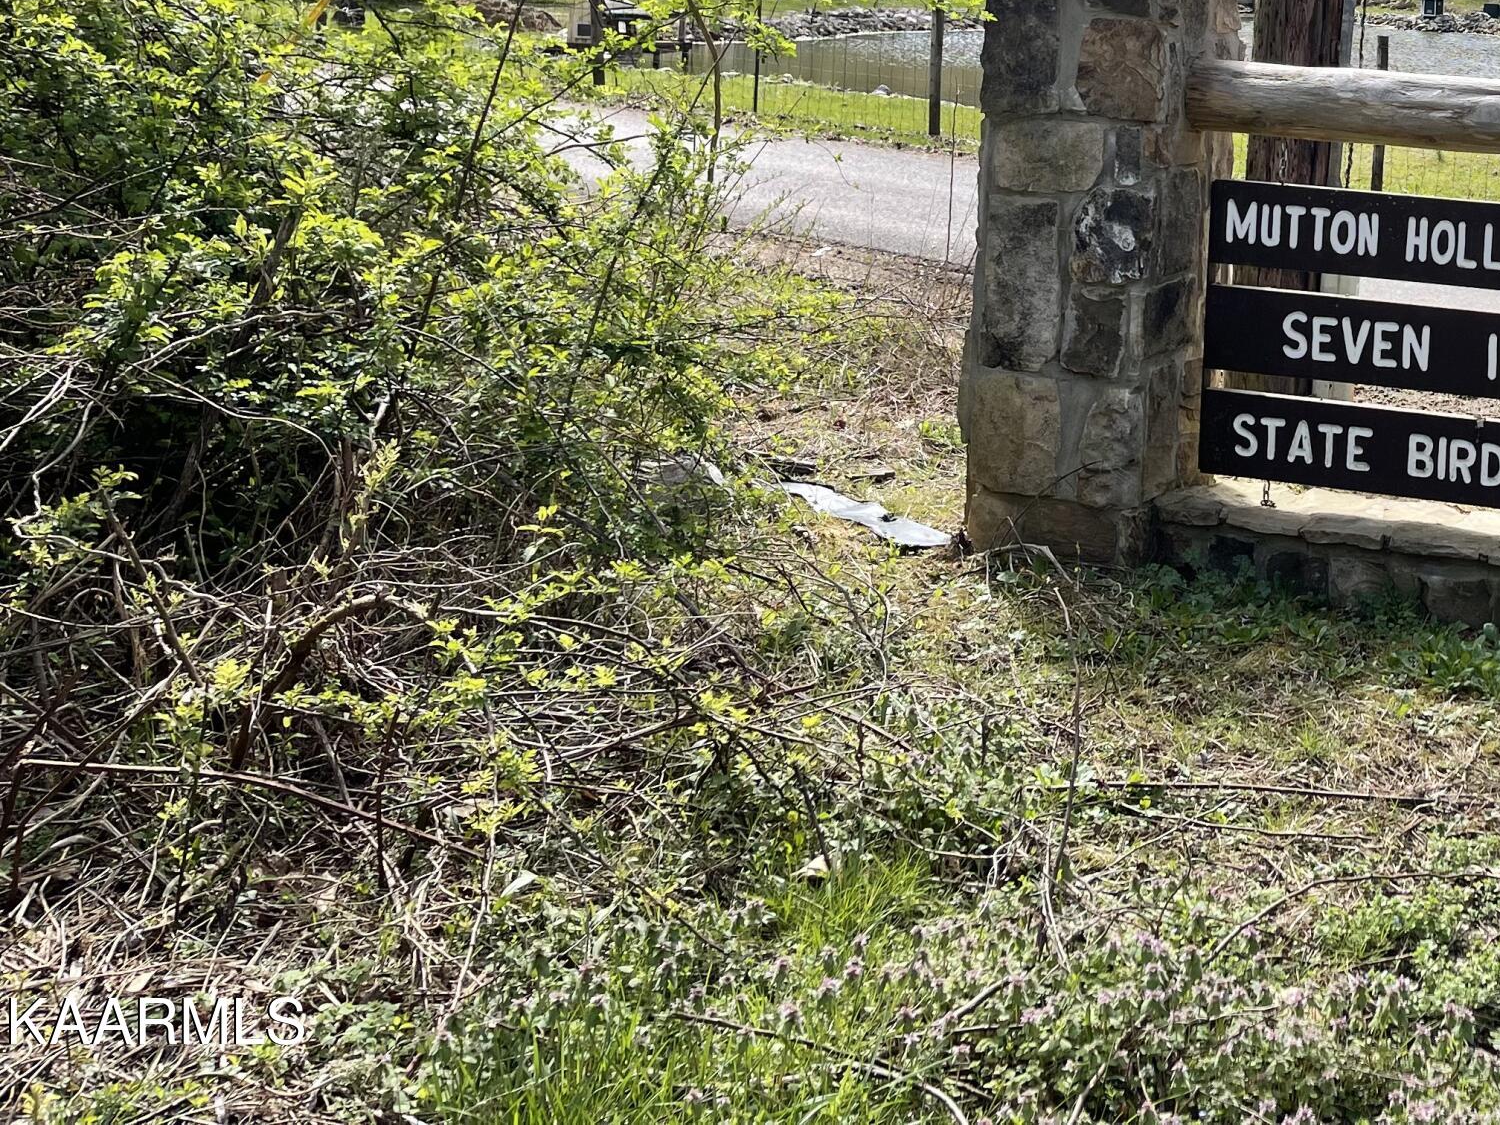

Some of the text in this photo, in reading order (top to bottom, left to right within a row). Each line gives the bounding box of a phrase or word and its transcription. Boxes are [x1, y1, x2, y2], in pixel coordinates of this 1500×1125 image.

[1224, 199, 1380, 258] MUTTON
[1281, 311, 1432, 373] SEVEN
[1232, 413, 1374, 473] STATE
